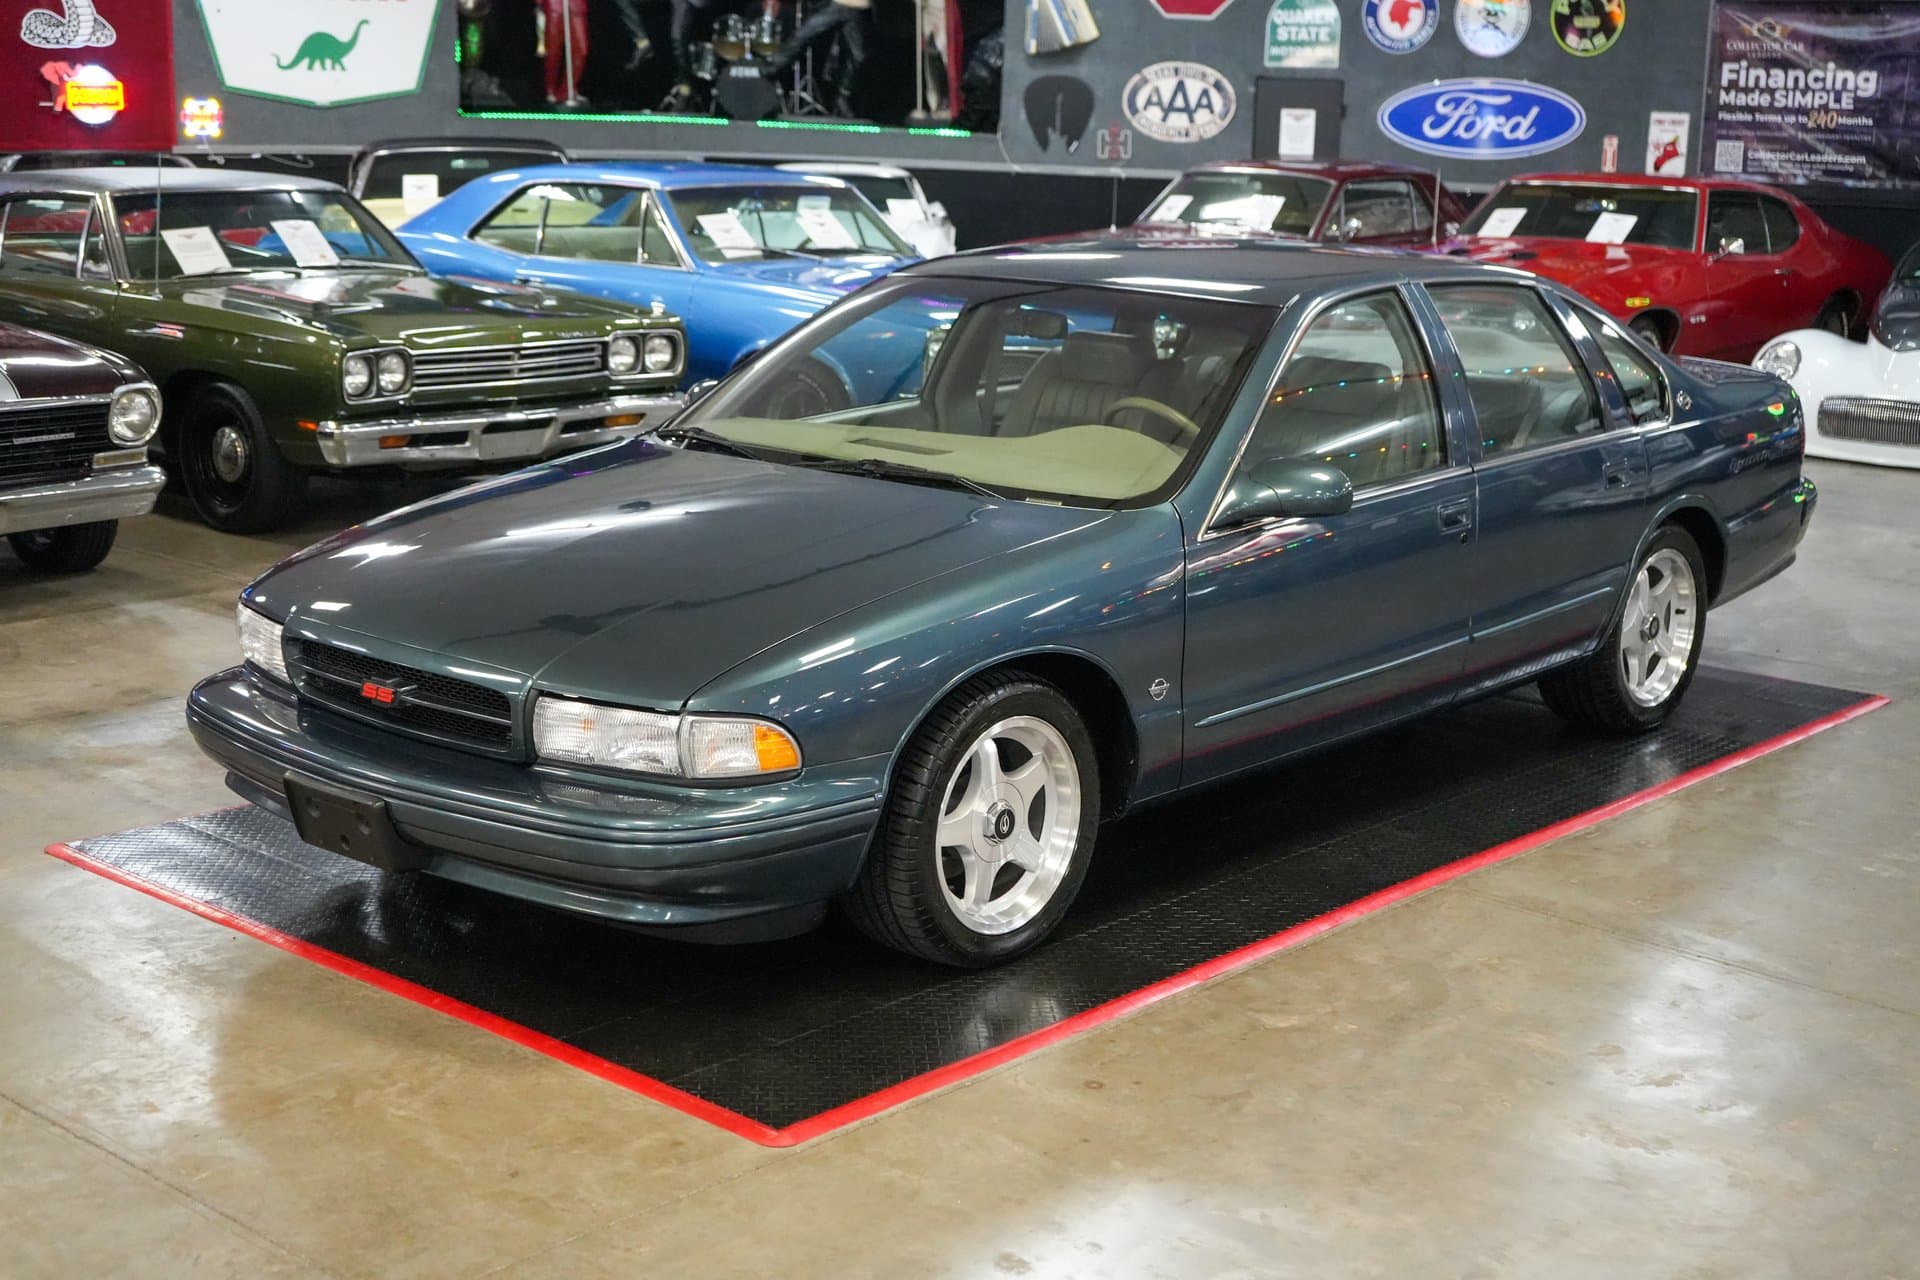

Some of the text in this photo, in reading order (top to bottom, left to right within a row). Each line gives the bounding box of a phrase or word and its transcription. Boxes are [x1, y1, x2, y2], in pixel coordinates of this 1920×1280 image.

[1272, 8, 1336, 25] QUAKER
[1276, 26, 1331, 42] STATE
[1720, 60, 1879, 98] Financing
[1143, 79, 1214, 124] AAA
[1719, 89, 1855, 110] Made SIMPLE
[1422, 91, 1541, 141] Ford
[1717, 109, 1874, 129] Flexible Terms up to 240 Months
[362, 682, 394, 703] SS
